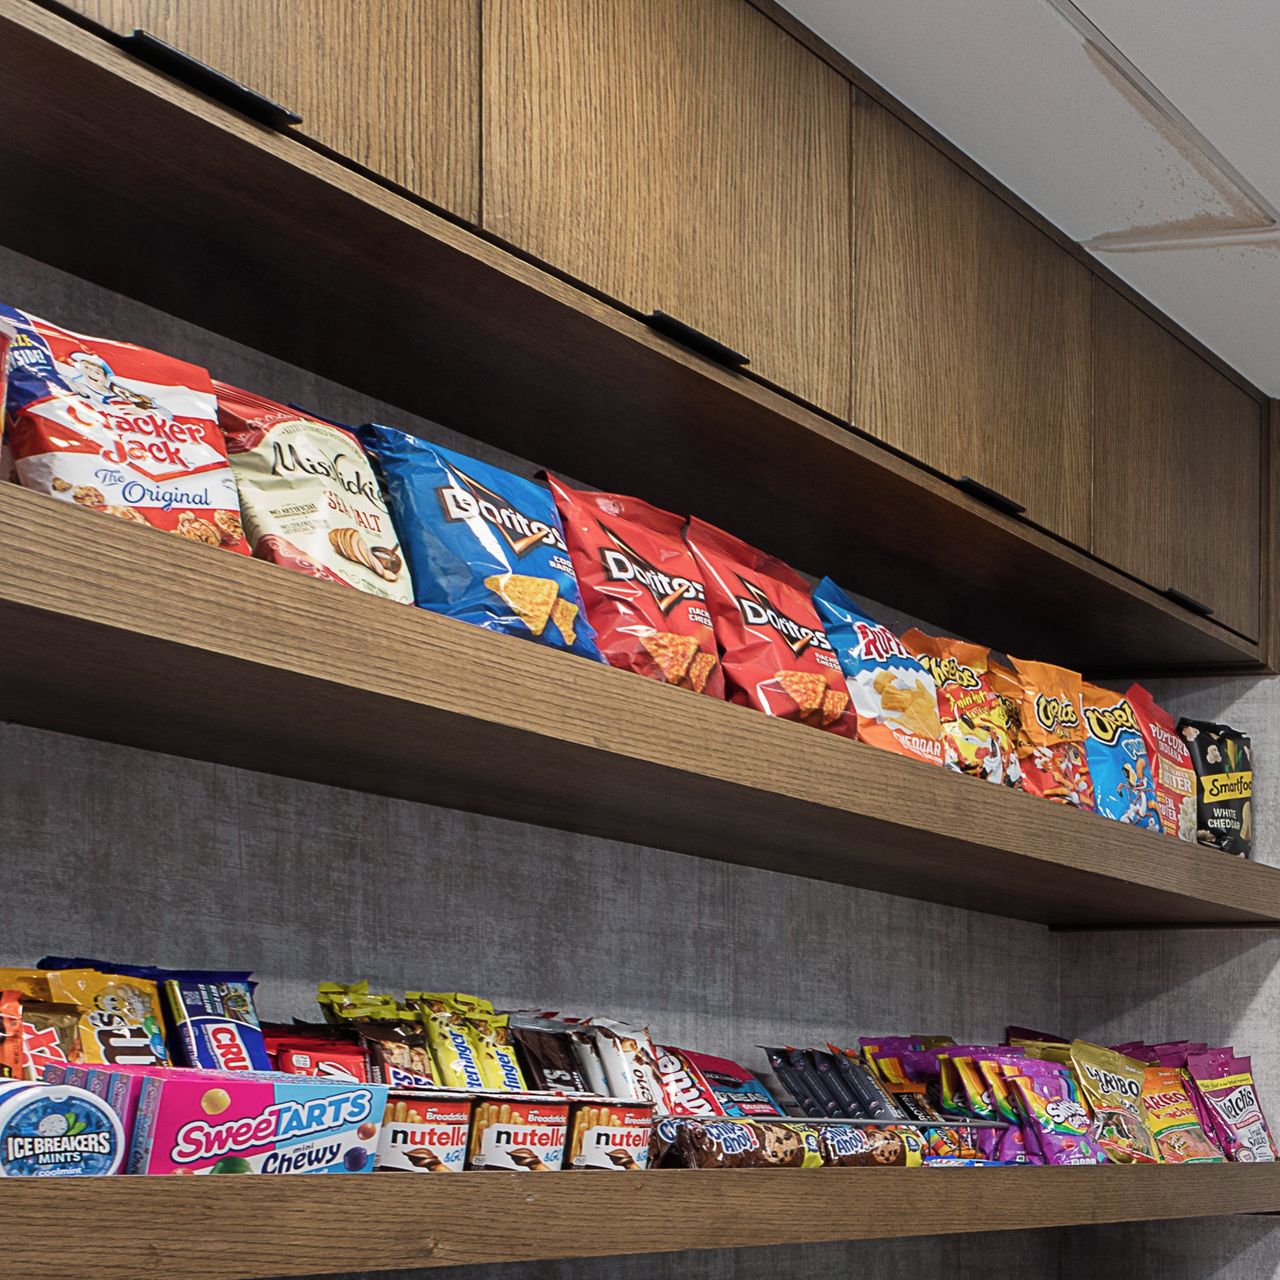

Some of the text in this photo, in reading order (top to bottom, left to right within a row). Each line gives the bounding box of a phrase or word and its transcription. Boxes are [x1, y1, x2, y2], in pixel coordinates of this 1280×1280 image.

[66, 399, 206, 446] Cracker
[99, 432, 193, 469] Jack
[94, 467, 125, 487] The
[121, 480, 212, 512] Original
[440, 486, 568, 551] Doritos
[602, 548, 706, 601] Doritos
[739, 596, 833, 652] Doritos
[1212, 808, 1237, 821] WHITE
[7, 1131, 111, 1161] ICE BREAKERS
[37, 1151, 82, 1165] MINTS
[291, 1142, 315, 1154] mini
